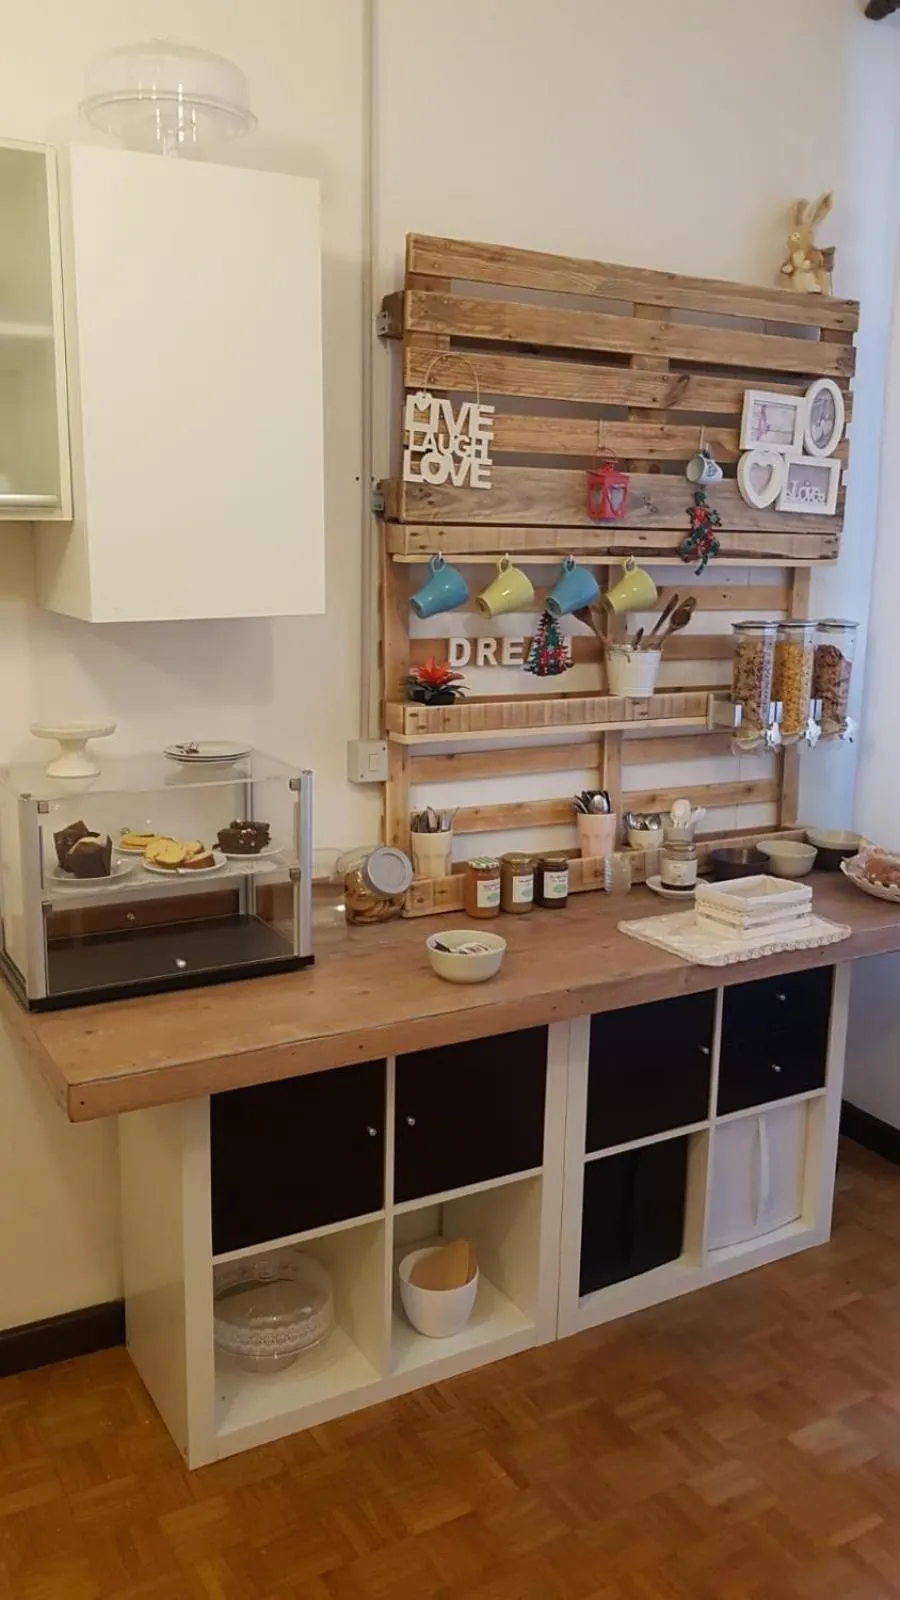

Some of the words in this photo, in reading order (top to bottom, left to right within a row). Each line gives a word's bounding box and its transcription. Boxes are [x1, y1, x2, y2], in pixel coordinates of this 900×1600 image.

[405, 392, 495, 440] LIVE
[408, 431, 490, 460] LAUGH
[403, 449, 493, 489] LOVE
[448, 636, 573, 667] DRE
